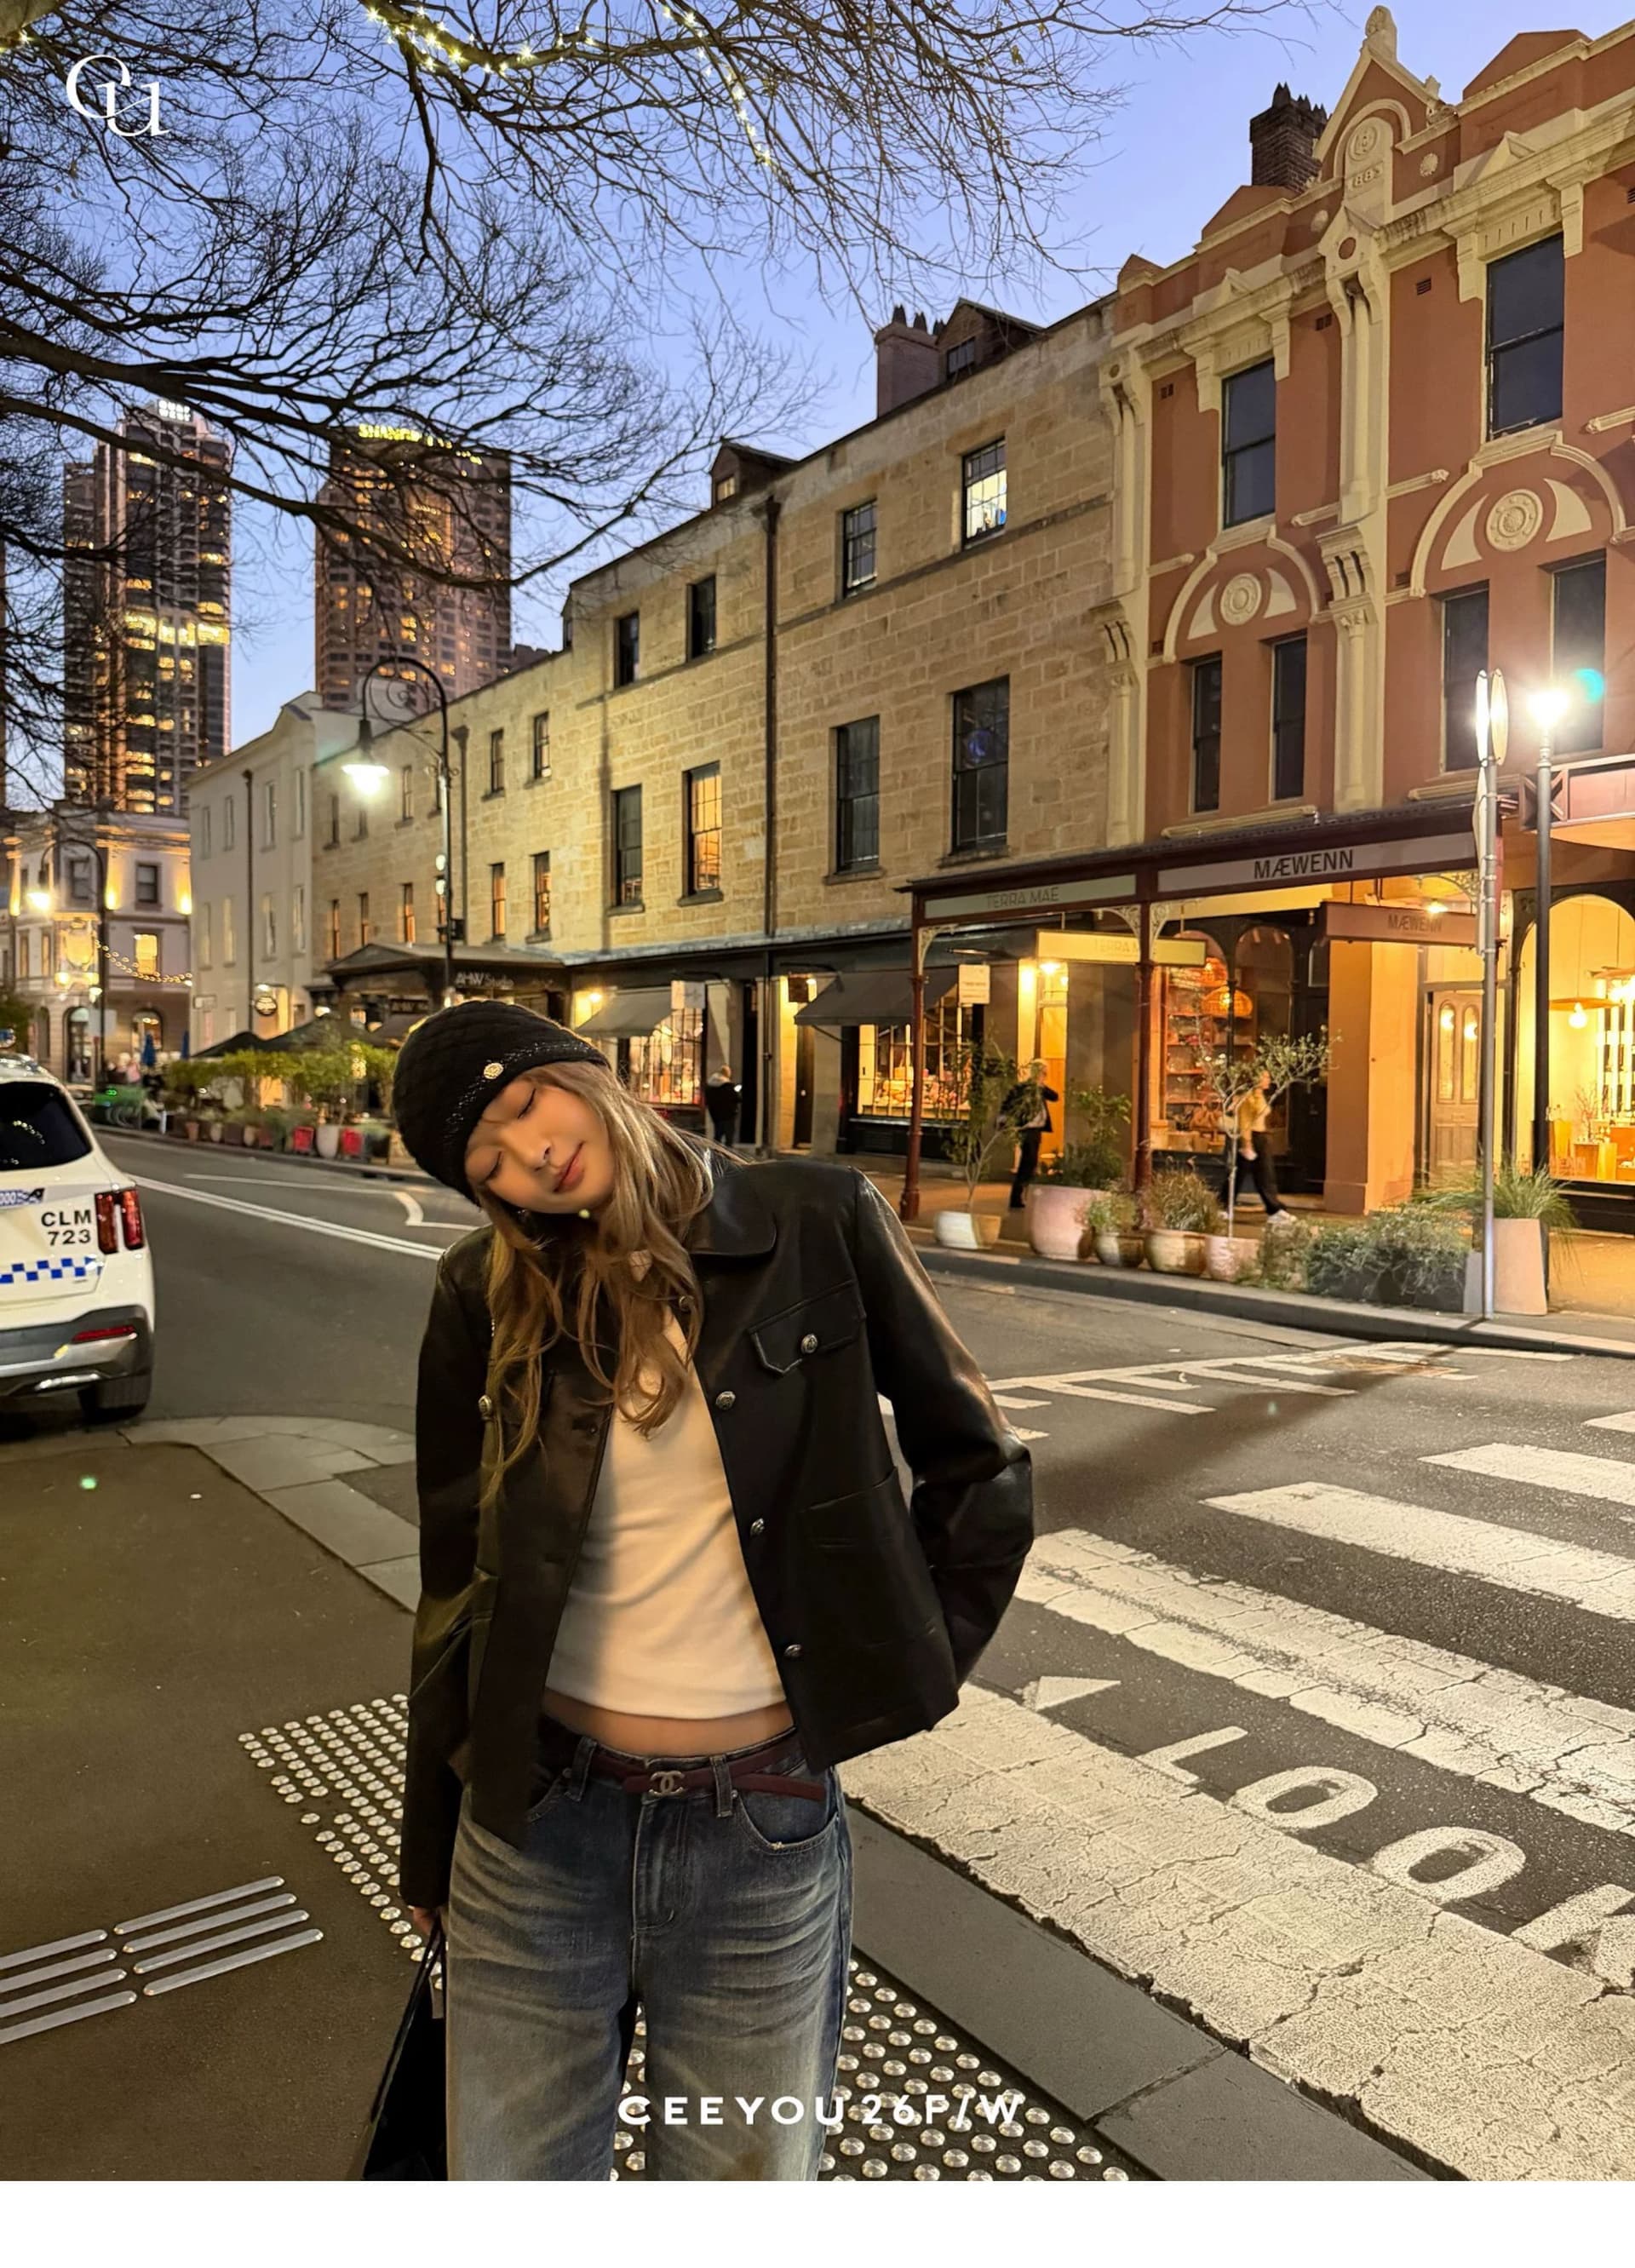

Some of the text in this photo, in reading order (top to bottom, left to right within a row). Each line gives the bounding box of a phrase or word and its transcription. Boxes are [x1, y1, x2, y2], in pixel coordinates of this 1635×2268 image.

[1254, 850, 1353, 880] MÆWENN
[986, 887, 1060, 909] TERRA MAE
[41, 1209, 91, 1226] CLM
[48, 1229, 91, 1245] 723
